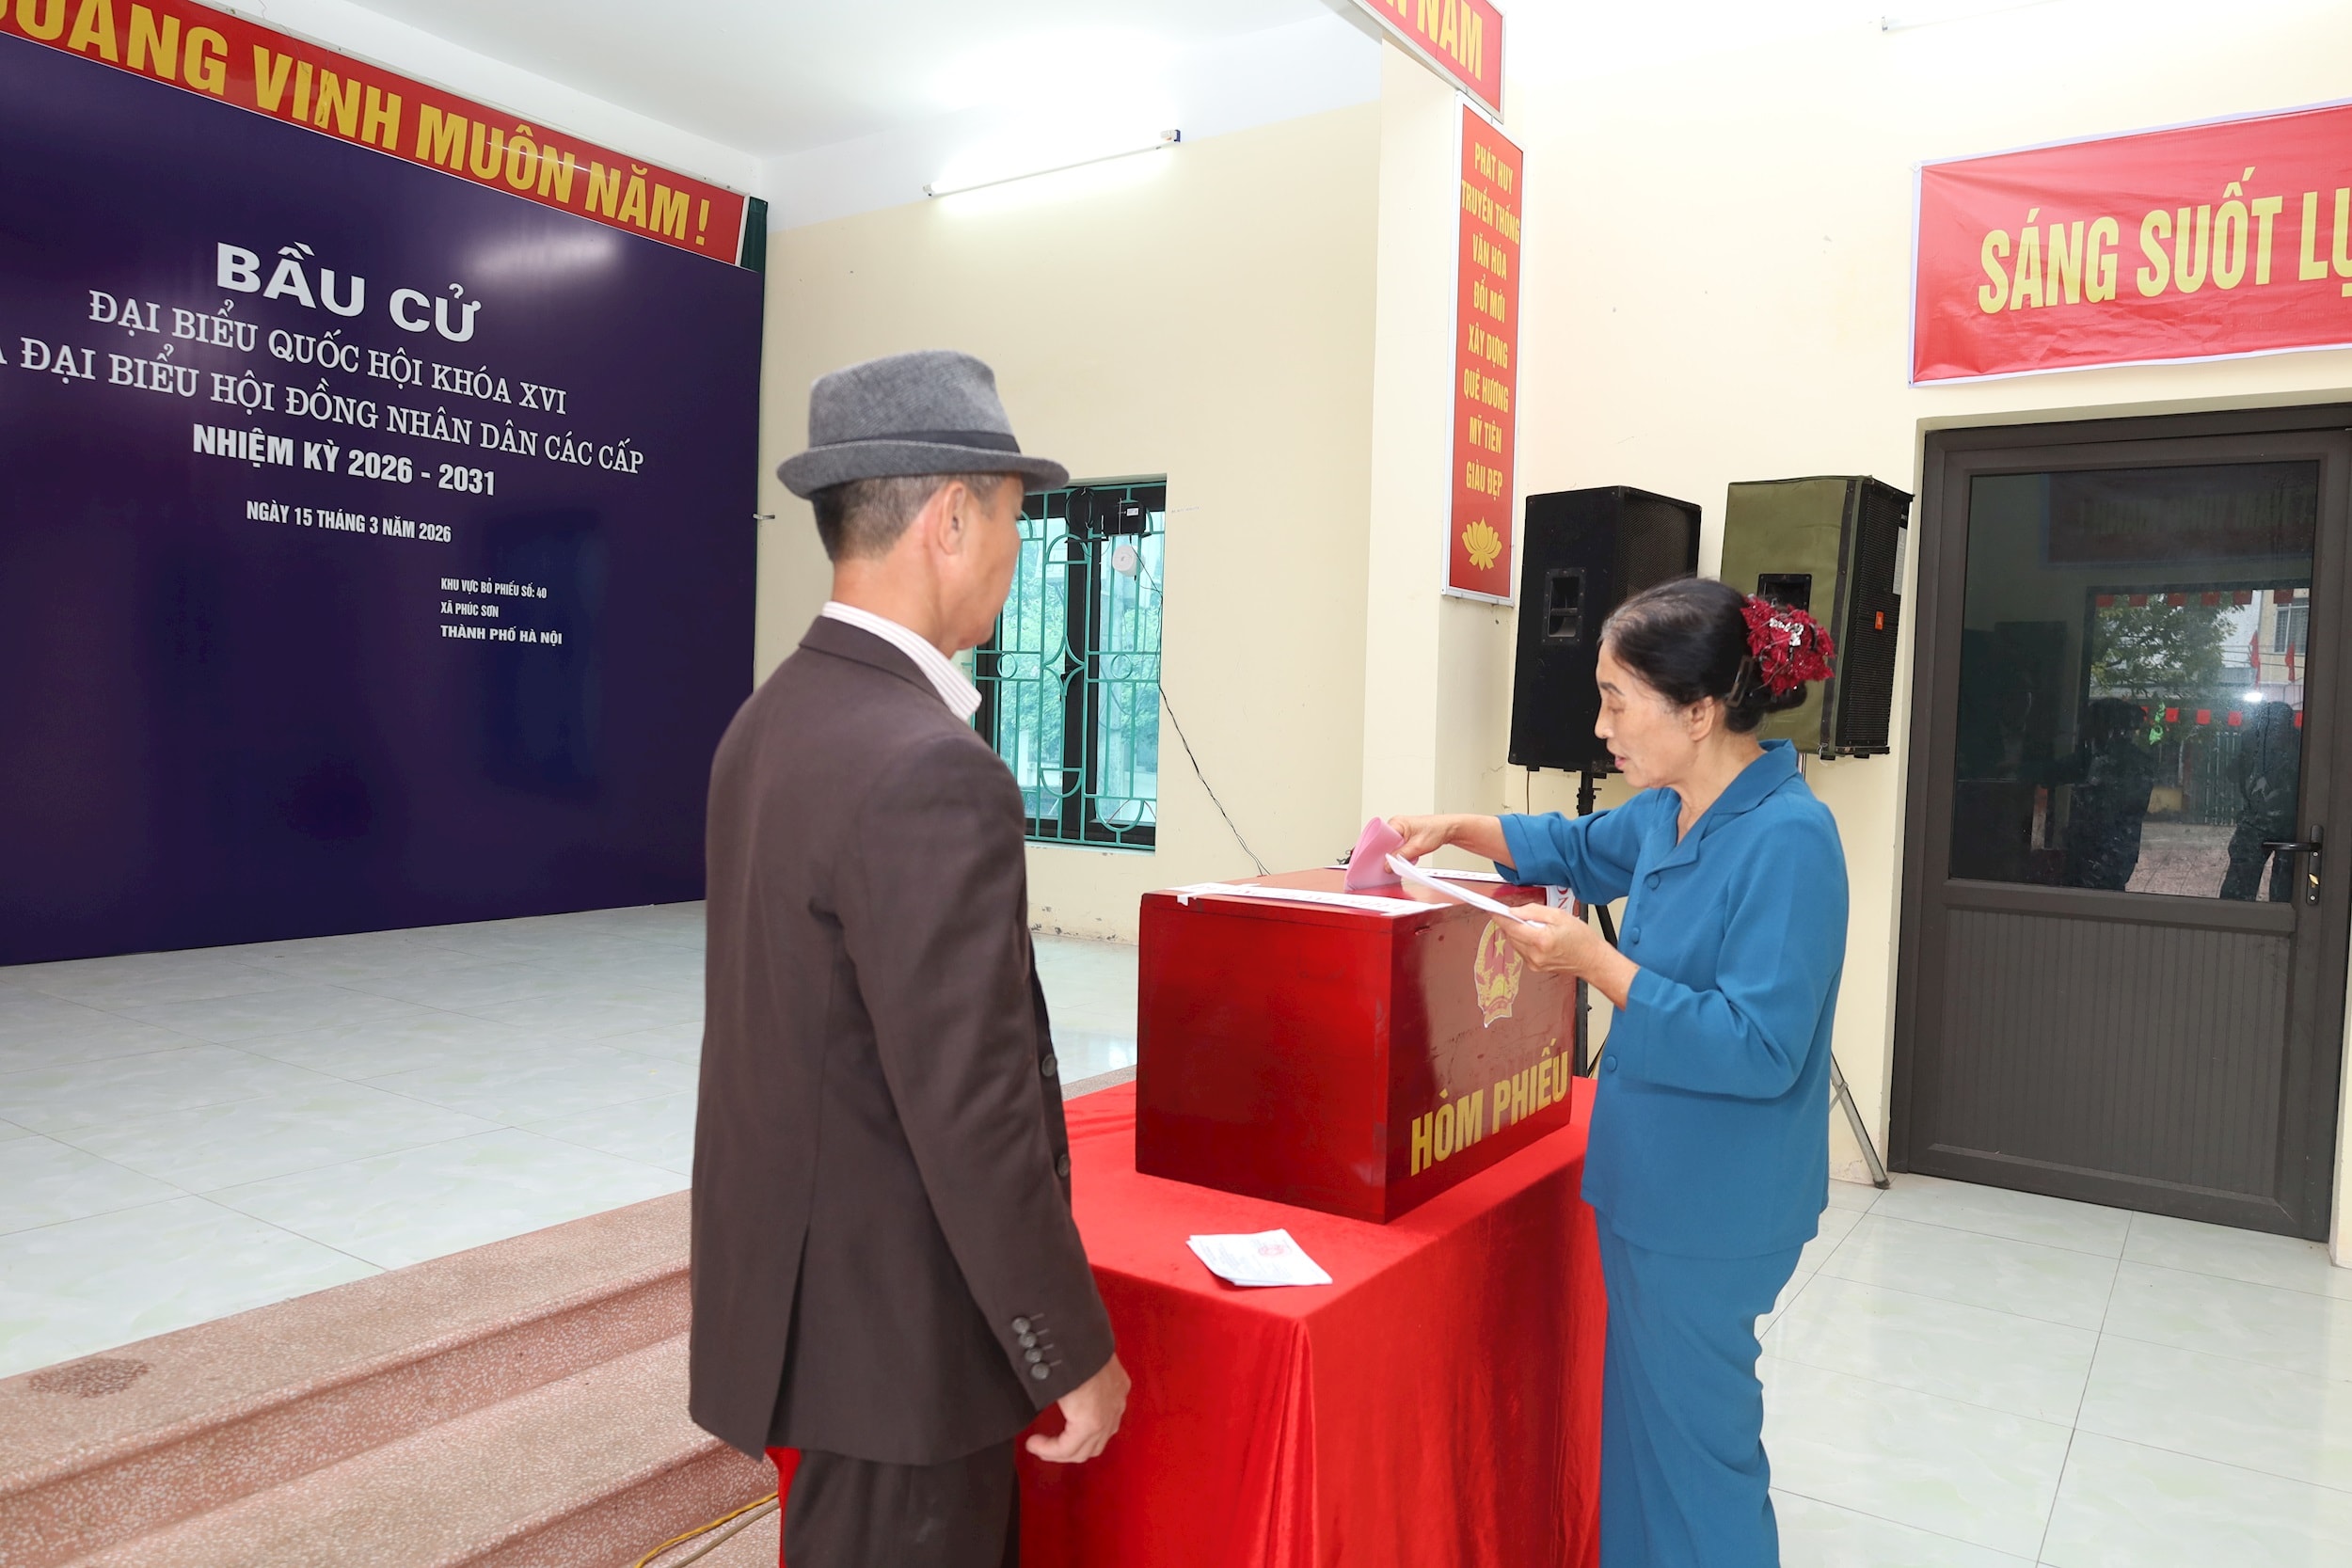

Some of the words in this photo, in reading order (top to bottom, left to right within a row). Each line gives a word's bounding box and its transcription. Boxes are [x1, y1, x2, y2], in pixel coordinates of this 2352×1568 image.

[0, 0, 228, 96] UANG
[253, 44, 402, 150] VINH
[415, 103, 576, 204] MUÔN
[1474, 141, 1497, 182] PHÁT
[1498, 161, 1514, 195] HUY
[1495, 203, 1520, 245] THỐNG
[1978, 207, 2121, 314] SÁNG
[2136, 166, 2283, 297] SUỐT
[1472, 232, 1489, 269] VĂN
[1490, 243, 1507, 280] HÓA
[216, 241, 365, 317] BẦU
[389, 282, 482, 342] CỬ
[1473, 273, 1488, 314] ĐỔI
[1489, 289, 1505, 324] MỚI
[88, 289, 160, 337] ĐẠI
[171, 298, 258, 352] BIỂU
[268, 328, 359, 372] QUỐC
[367, 346, 422, 389] HỘI
[431, 364, 512, 404] KHÓA
[518, 381, 567, 415] XVI
[1468, 322, 1485, 357] XÂY
[1486, 333, 1508, 369] DỰNG
[20, 336, 96, 385] ĐẠI
[108, 343, 199, 398] BIỂU
[210, 369, 275, 415] HỘI
[285, 377, 378, 429] ĐỒNG
[386, 405, 472, 445] NHÂN
[480, 419, 538, 456] DÂN
[544, 430, 593, 467] CÁC
[598, 437, 644, 474] CẤP
[1464, 368, 1481, 401] QUÊ
[1482, 375, 1509, 414] HƯƠNG
[1469, 414, 1483, 447] MỸ
[1484, 420, 1502, 454] TIÊN
[193, 422, 294, 468] NHIỆM
[303, 438, 340, 472] KỲ
[347, 448, 413, 483] 2026
[437, 463, 495, 496] 2031
[1466, 459, 1486, 493] GIÀU
[1486, 467, 1503, 501] ĐẸP
[246, 499, 290, 524] NGÀY
[294, 507, 312, 527] 15
[316, 508, 365, 533] THÁNG
[369, 516, 378, 534] 3
[382, 515, 415, 539] NĂM
[419, 522, 452, 543] 2026
[440, 578, 459, 591] KHU
[461, 578, 479, 594] VỰC
[481, 577, 492, 594] BỎ
[494, 579, 519, 596] PHIẾU
[520, 582, 535, 598] SỐ:
[536, 587, 548, 599] 40
[440, 600, 453, 614] XÃ
[455, 601, 479, 616] PHÚC
[481, 604, 500, 618] SƠN
[440, 623, 485, 640] THÀNH
[489, 626, 516, 641] PHỐ
[519, 628, 537, 643] HÀ
[540, 630, 563, 646] NỘI
[1411, 1087, 1484, 1177] HÒM
[1491, 1037, 1568, 1134] PHIẾU
